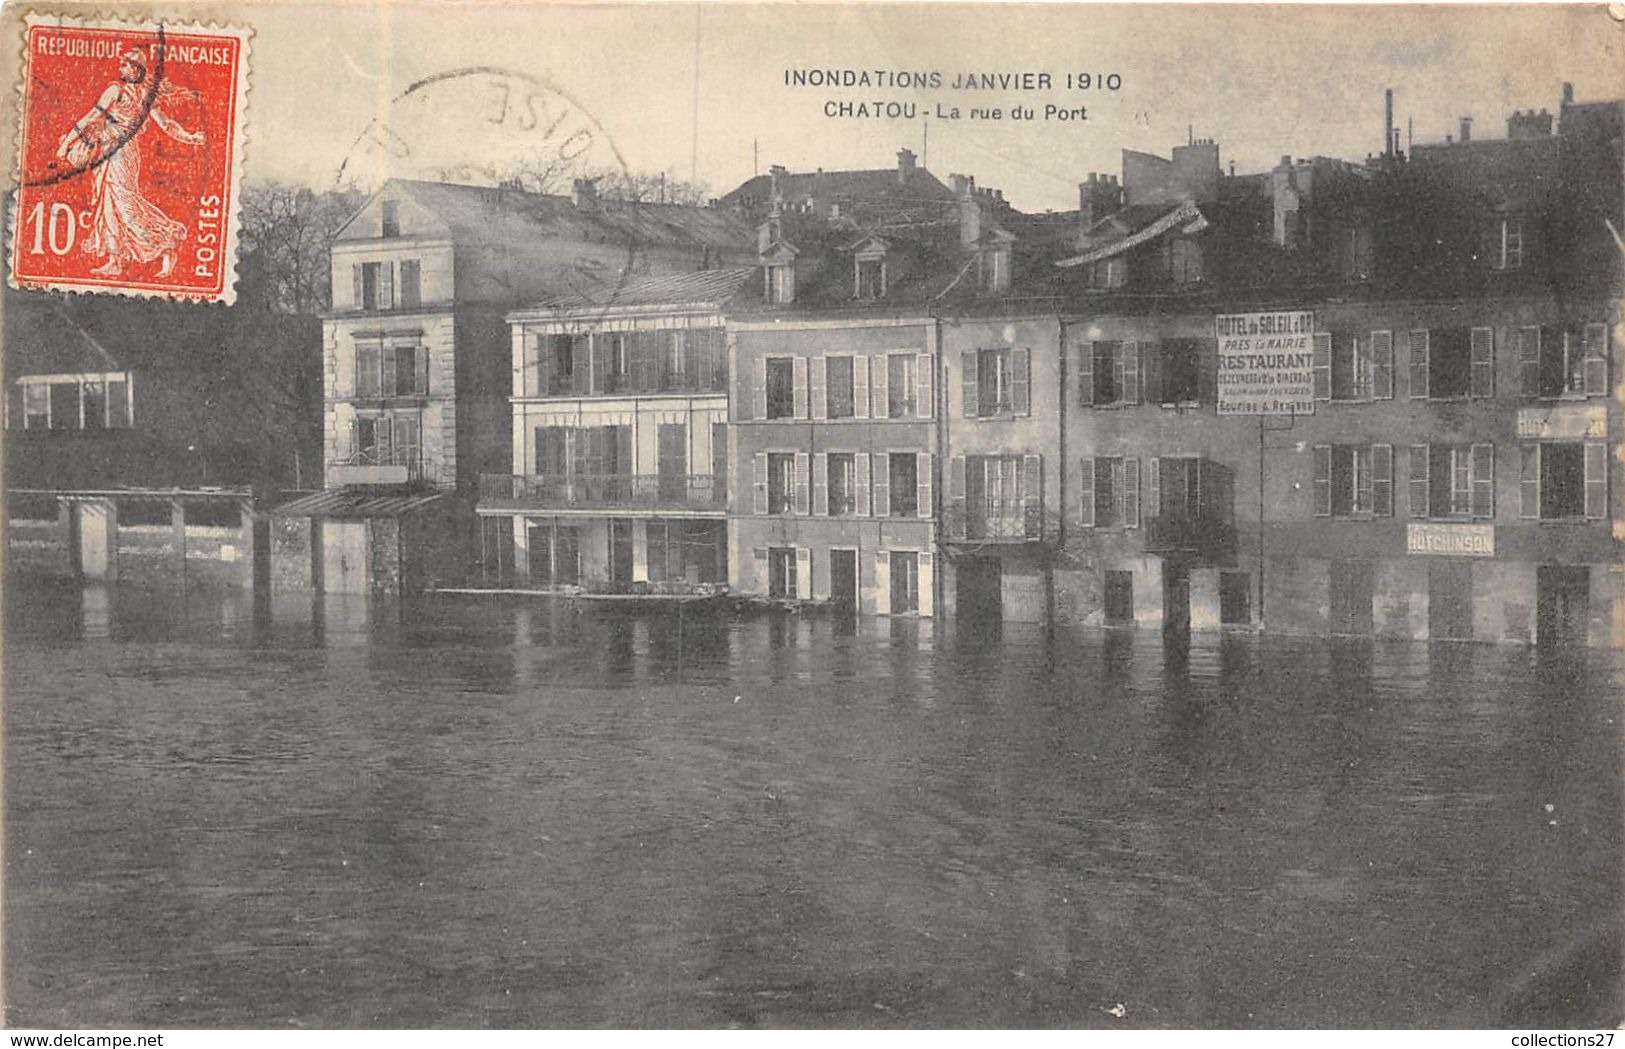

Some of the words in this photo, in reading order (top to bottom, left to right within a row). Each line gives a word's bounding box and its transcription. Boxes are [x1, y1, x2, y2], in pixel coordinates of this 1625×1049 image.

[149, 42, 230, 65] FRANÇAISE
[195, 195, 220, 278] POSTES
[1259, 315, 1293, 335] SOLEIL
[1268, 337, 1307, 350] MAIRIE
[1217, 353, 1313, 370] RESTAURANT
[1408, 535, 1495, 552] HUTCHINSON
